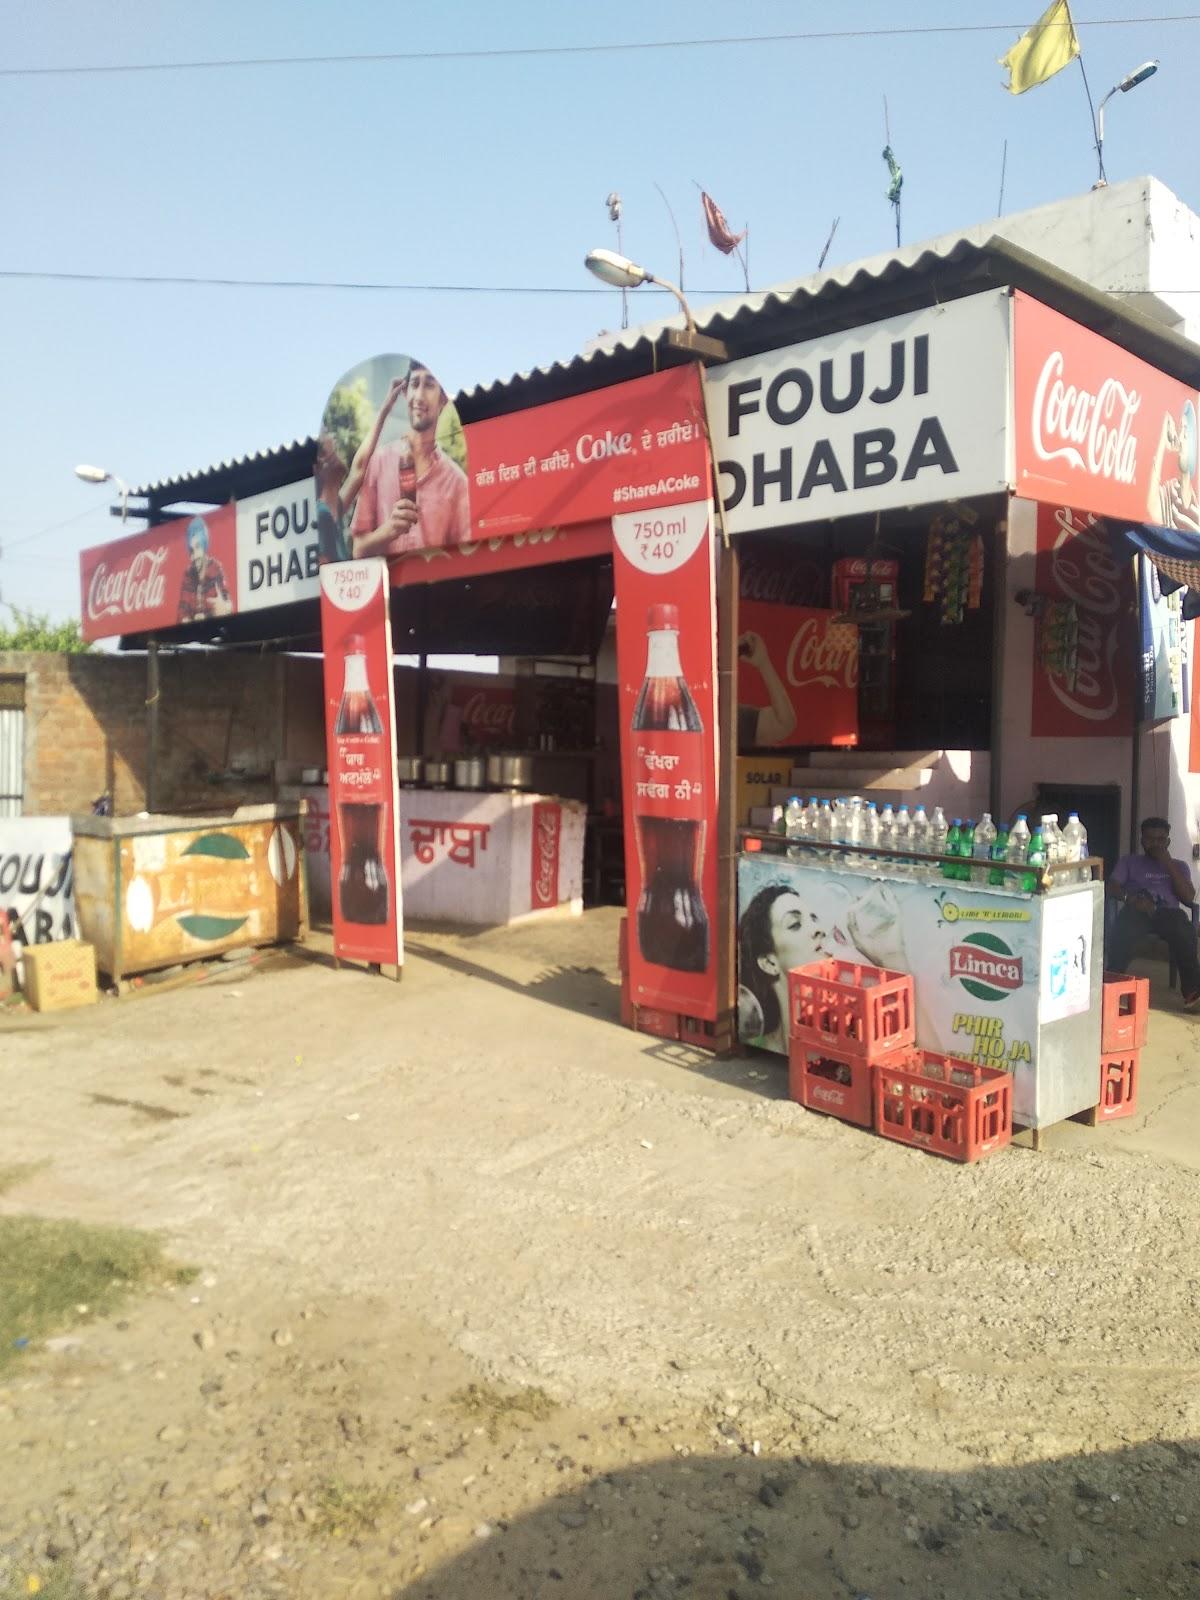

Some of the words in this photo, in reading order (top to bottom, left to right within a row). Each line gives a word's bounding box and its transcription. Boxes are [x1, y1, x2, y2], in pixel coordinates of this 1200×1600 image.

[728, 333, 930, 437] FOUJI
[1032, 351, 1141, 485] Coca-Cola
[717, 416, 960, 512] DHABA
[613, 475, 700, 502] #ShareACoke
[88, 546, 169, 620] Coca-Cola
[746, 772, 782, 785] SOLAR
[408, 819, 490, 868] ਢਾਬਾ
[0, 853, 72, 899] OUJI
[953, 952, 1020, 981] Limca
[952, 1013, 1004, 1038] PHIR
[974, 1035, 1005, 1058] HO
[1008, 1040, 1032, 1064] JA
